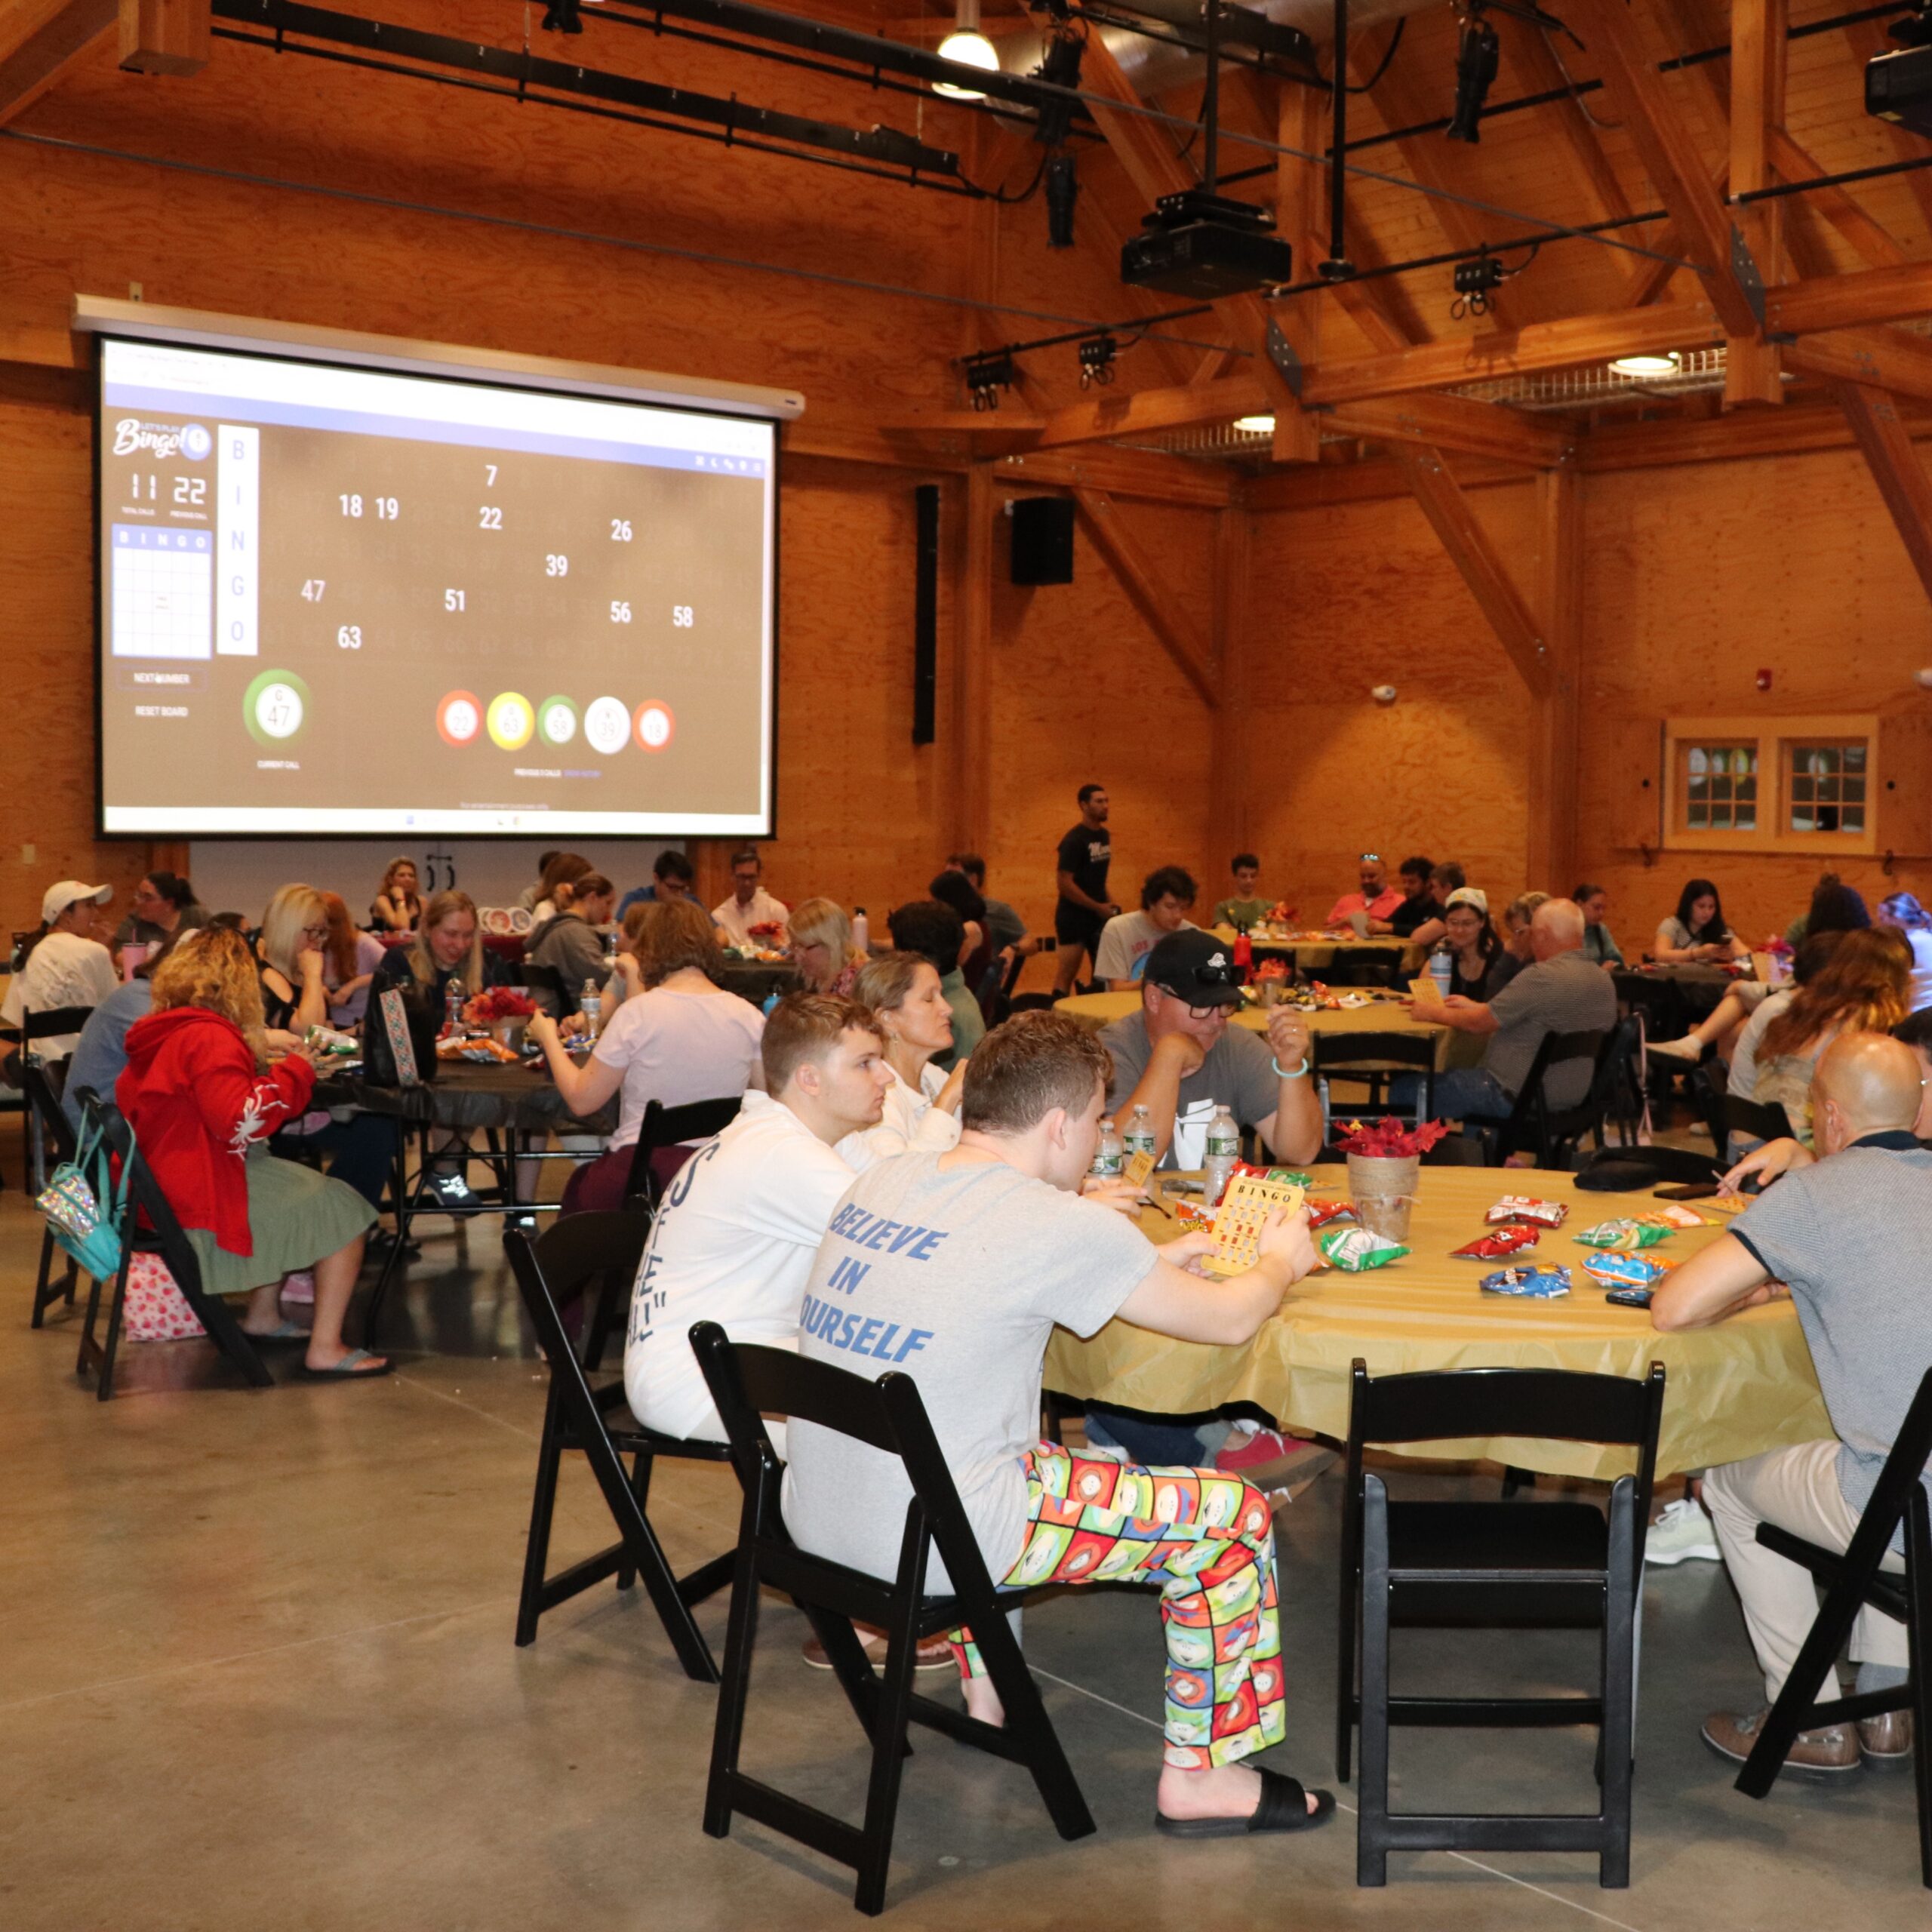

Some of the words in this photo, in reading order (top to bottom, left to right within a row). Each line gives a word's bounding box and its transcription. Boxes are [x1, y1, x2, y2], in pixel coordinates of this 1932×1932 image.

[132, 473, 156, 500] 11
[485, 465, 497, 487] 7
[174, 477, 206, 505] 22
[339, 494, 363, 518] 18
[376, 497, 399, 520] 19
[479, 506, 503, 530] 22
[611, 518, 632, 542] 26
[546, 554, 568, 577] 39
[301, 580, 326, 601] 47
[445, 589, 465, 611] 51
[611, 601, 632, 623] 56
[673, 606, 694, 628] 58
[337, 626, 362, 649] 63
[275, 690, 283, 701] G
[135, 706, 160, 716] RESET
[161, 706, 189, 717] BOARD
[267, 705, 291, 727] 47
[453, 715, 469, 731] 22
[503, 718, 519, 733] 63
[552, 721, 568, 735] 58
[601, 721, 615, 737] 39
[648, 724, 662, 738] 18
[830, 1203, 949, 1261] BELIEVE
[828, 1256, 871, 1295] IN
[800, 1294, 934, 1363] OURSELF
